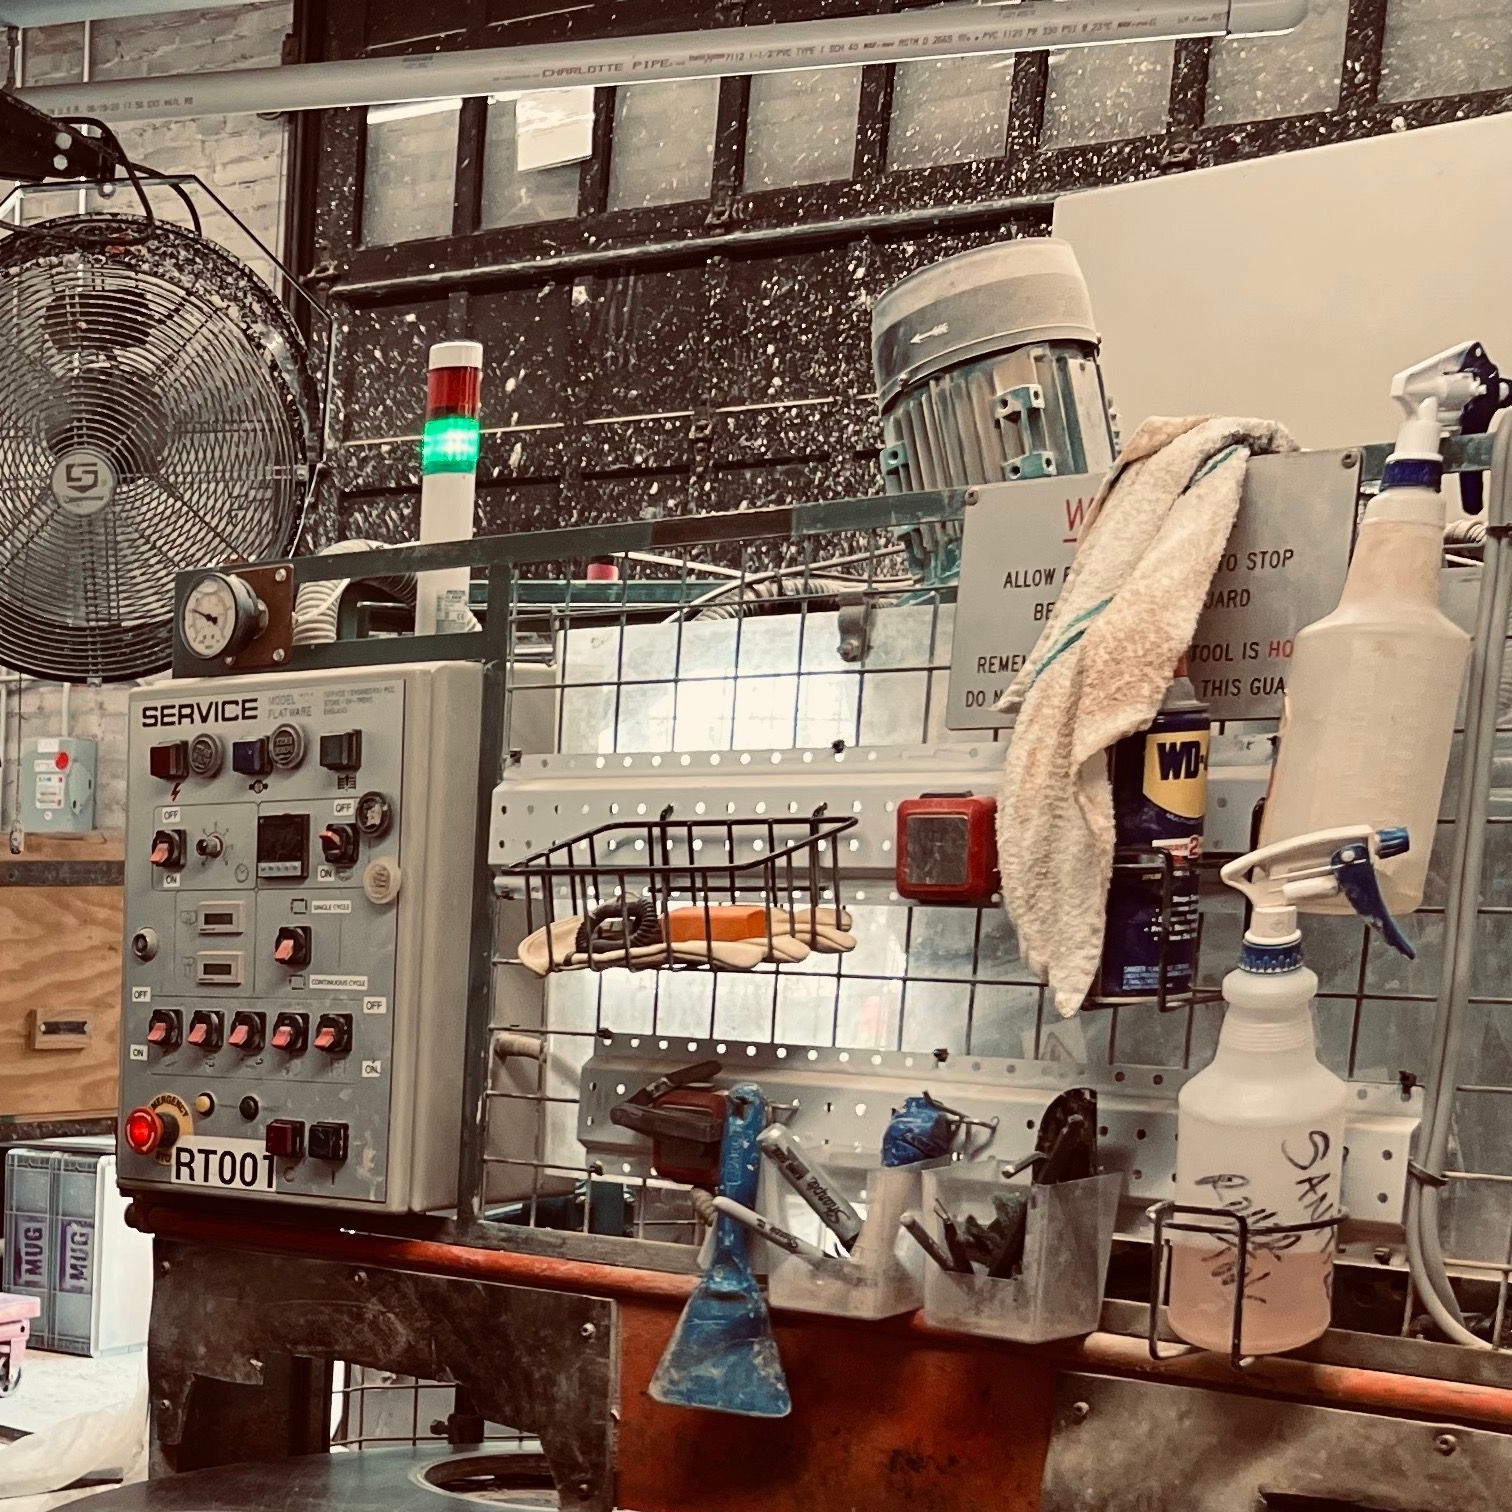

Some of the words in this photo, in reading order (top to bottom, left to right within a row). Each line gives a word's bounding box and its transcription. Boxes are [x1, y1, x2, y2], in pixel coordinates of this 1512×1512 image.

[796, 47, 814, 56] TYPE
[542, 63, 624, 78] CHARLOTTE
[1246, 549, 1294, 571] STOP
[1003, 568, 1056, 589] ALLOW
[1204, 588, 1251, 610] UARD
[1189, 643, 1234, 663] TOOL
[1242, 642, 1260, 660] IS
[1268, 640, 1294, 658] HO
[1201, 678, 1242, 698] THIS
[1250, 676, 1287, 696] GUA
[965, 690, 987, 708] DO
[142, 698, 259, 728] SERVICE
[1156, 740, 1209, 781] WD-
[163, 810, 179, 820] OFF
[335, 803, 352, 813] OFF
[165, 874, 178, 885] ON
[319, 868, 332, 879] ON
[311, 975, 348, 986] CONTINUOUS
[349, 977, 366, 987] CYCLE
[134, 990, 149, 1000] OFF
[365, 1001, 383, 1011] OFF
[132, 1048, 144, 1058] ON
[365, 1064, 380, 1075] ON
[151, 1095, 189, 1117] MERGENCY
[175, 1146, 275, 1189] RT001
[23, 1226, 44, 1277] MUG
[69, 1230, 89, 1281] MUG
